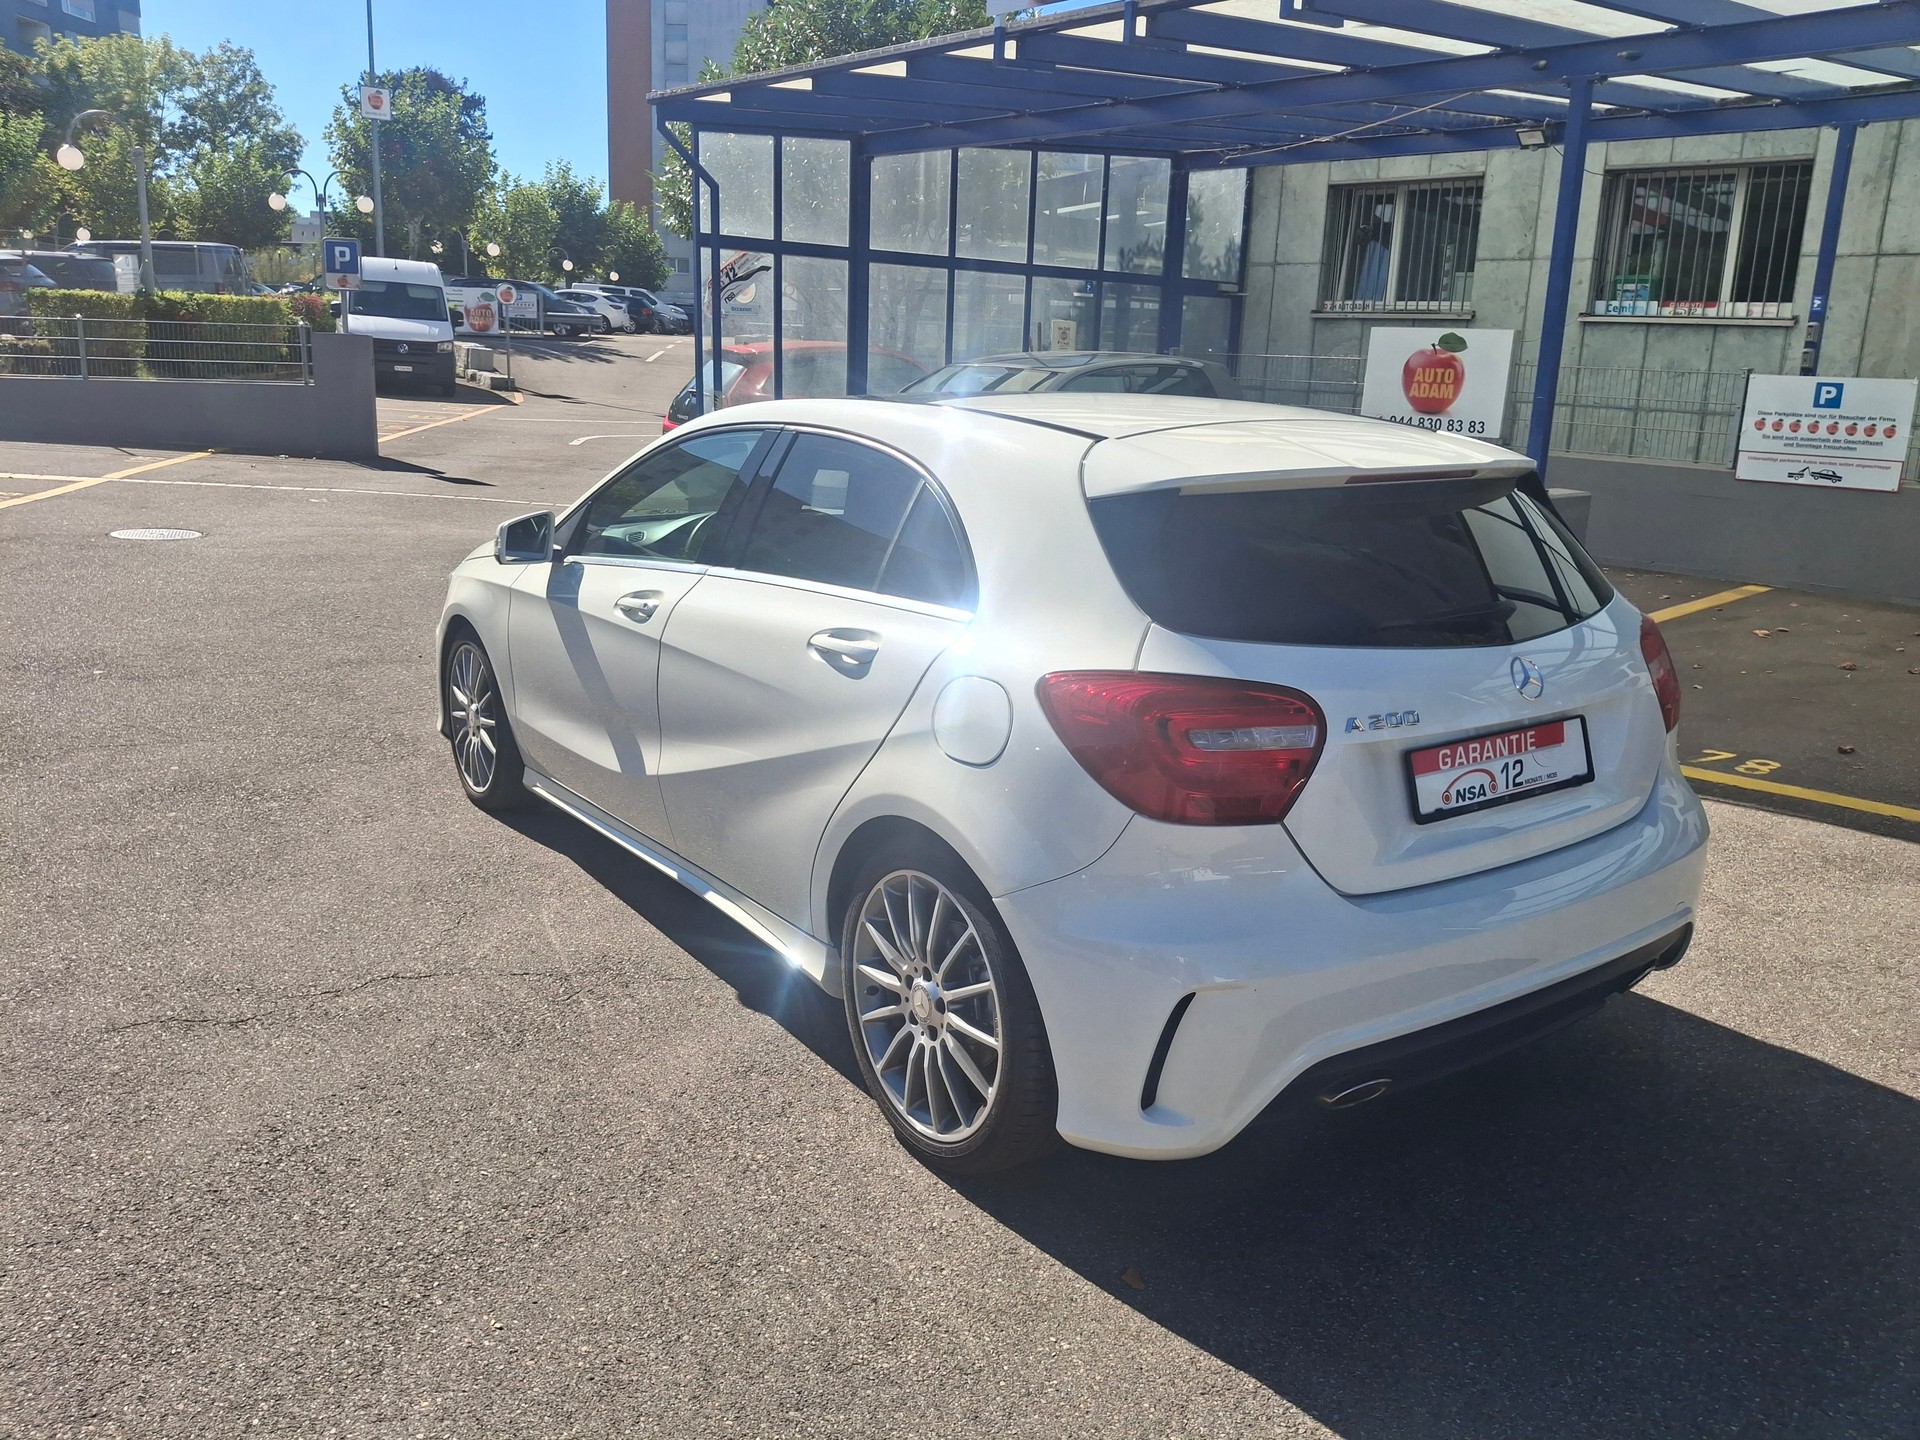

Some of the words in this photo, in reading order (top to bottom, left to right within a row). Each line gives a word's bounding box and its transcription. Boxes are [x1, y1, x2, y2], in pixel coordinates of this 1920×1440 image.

[334, 246, 350, 270] P
[470, 308, 492, 317] AUTO
[1413, 367, 1455, 384] AUTO
[1409, 382, 1455, 399] ADAM
[1819, 386, 1837, 405] P
[1418, 417, 1442, 431] 830
[1446, 419, 1463, 432] 83
[1468, 420, 1485, 434] 83
[1345, 717, 1365, 733] A
[1368, 710, 1420, 731] 200
[1438, 730, 1537, 770] GARANTIE
[1455, 783, 1487, 804] NSA
[1500, 758, 1524, 790] 12
[1524, 775, 1543, 785] MONATE
[1547, 771, 1558, 779] MOIS
